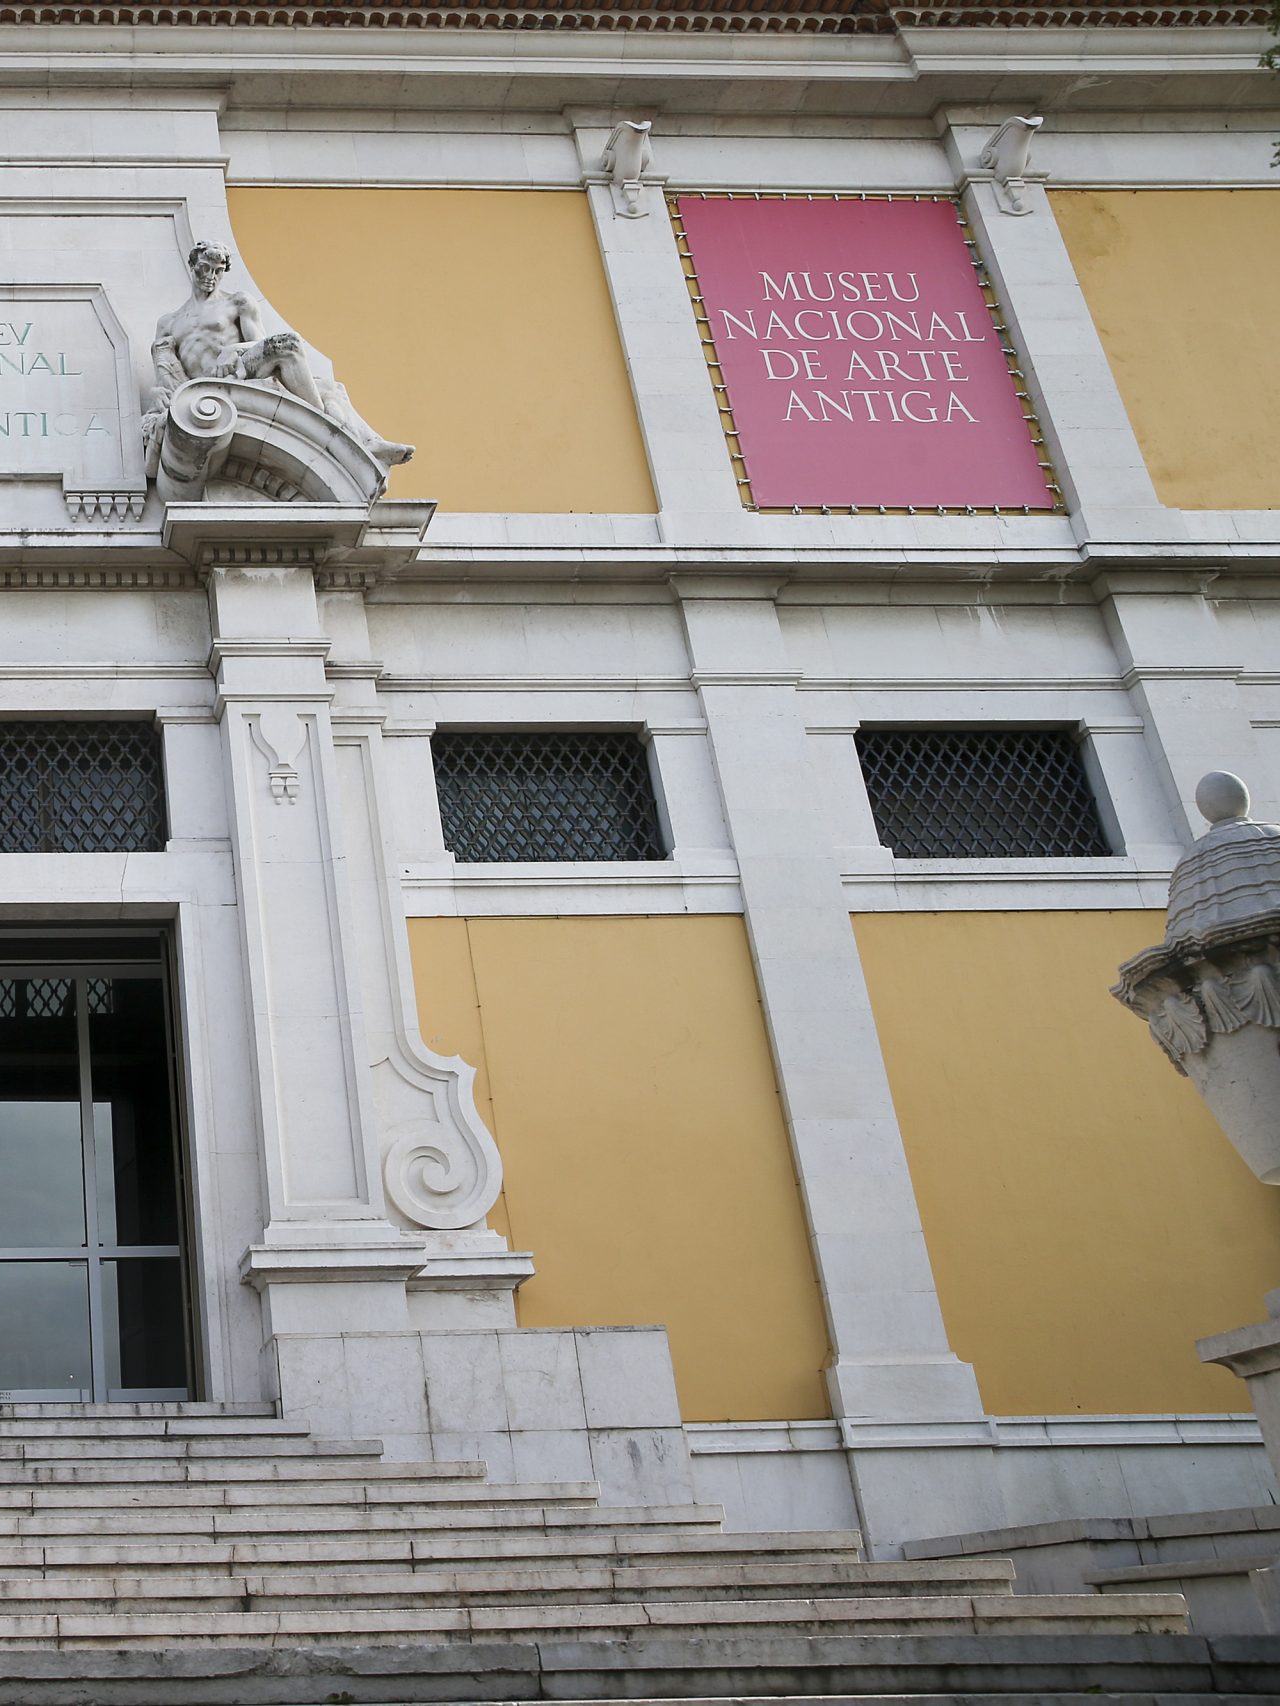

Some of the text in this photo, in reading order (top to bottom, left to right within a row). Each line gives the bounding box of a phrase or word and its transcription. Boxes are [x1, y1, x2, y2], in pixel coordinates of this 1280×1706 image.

[758, 271, 921, 302] MUSEU
[718, 309, 986, 342] NACIONAL
[758, 349, 970, 382] DE ARTE
[781, 390, 982, 423] ANTIGA
